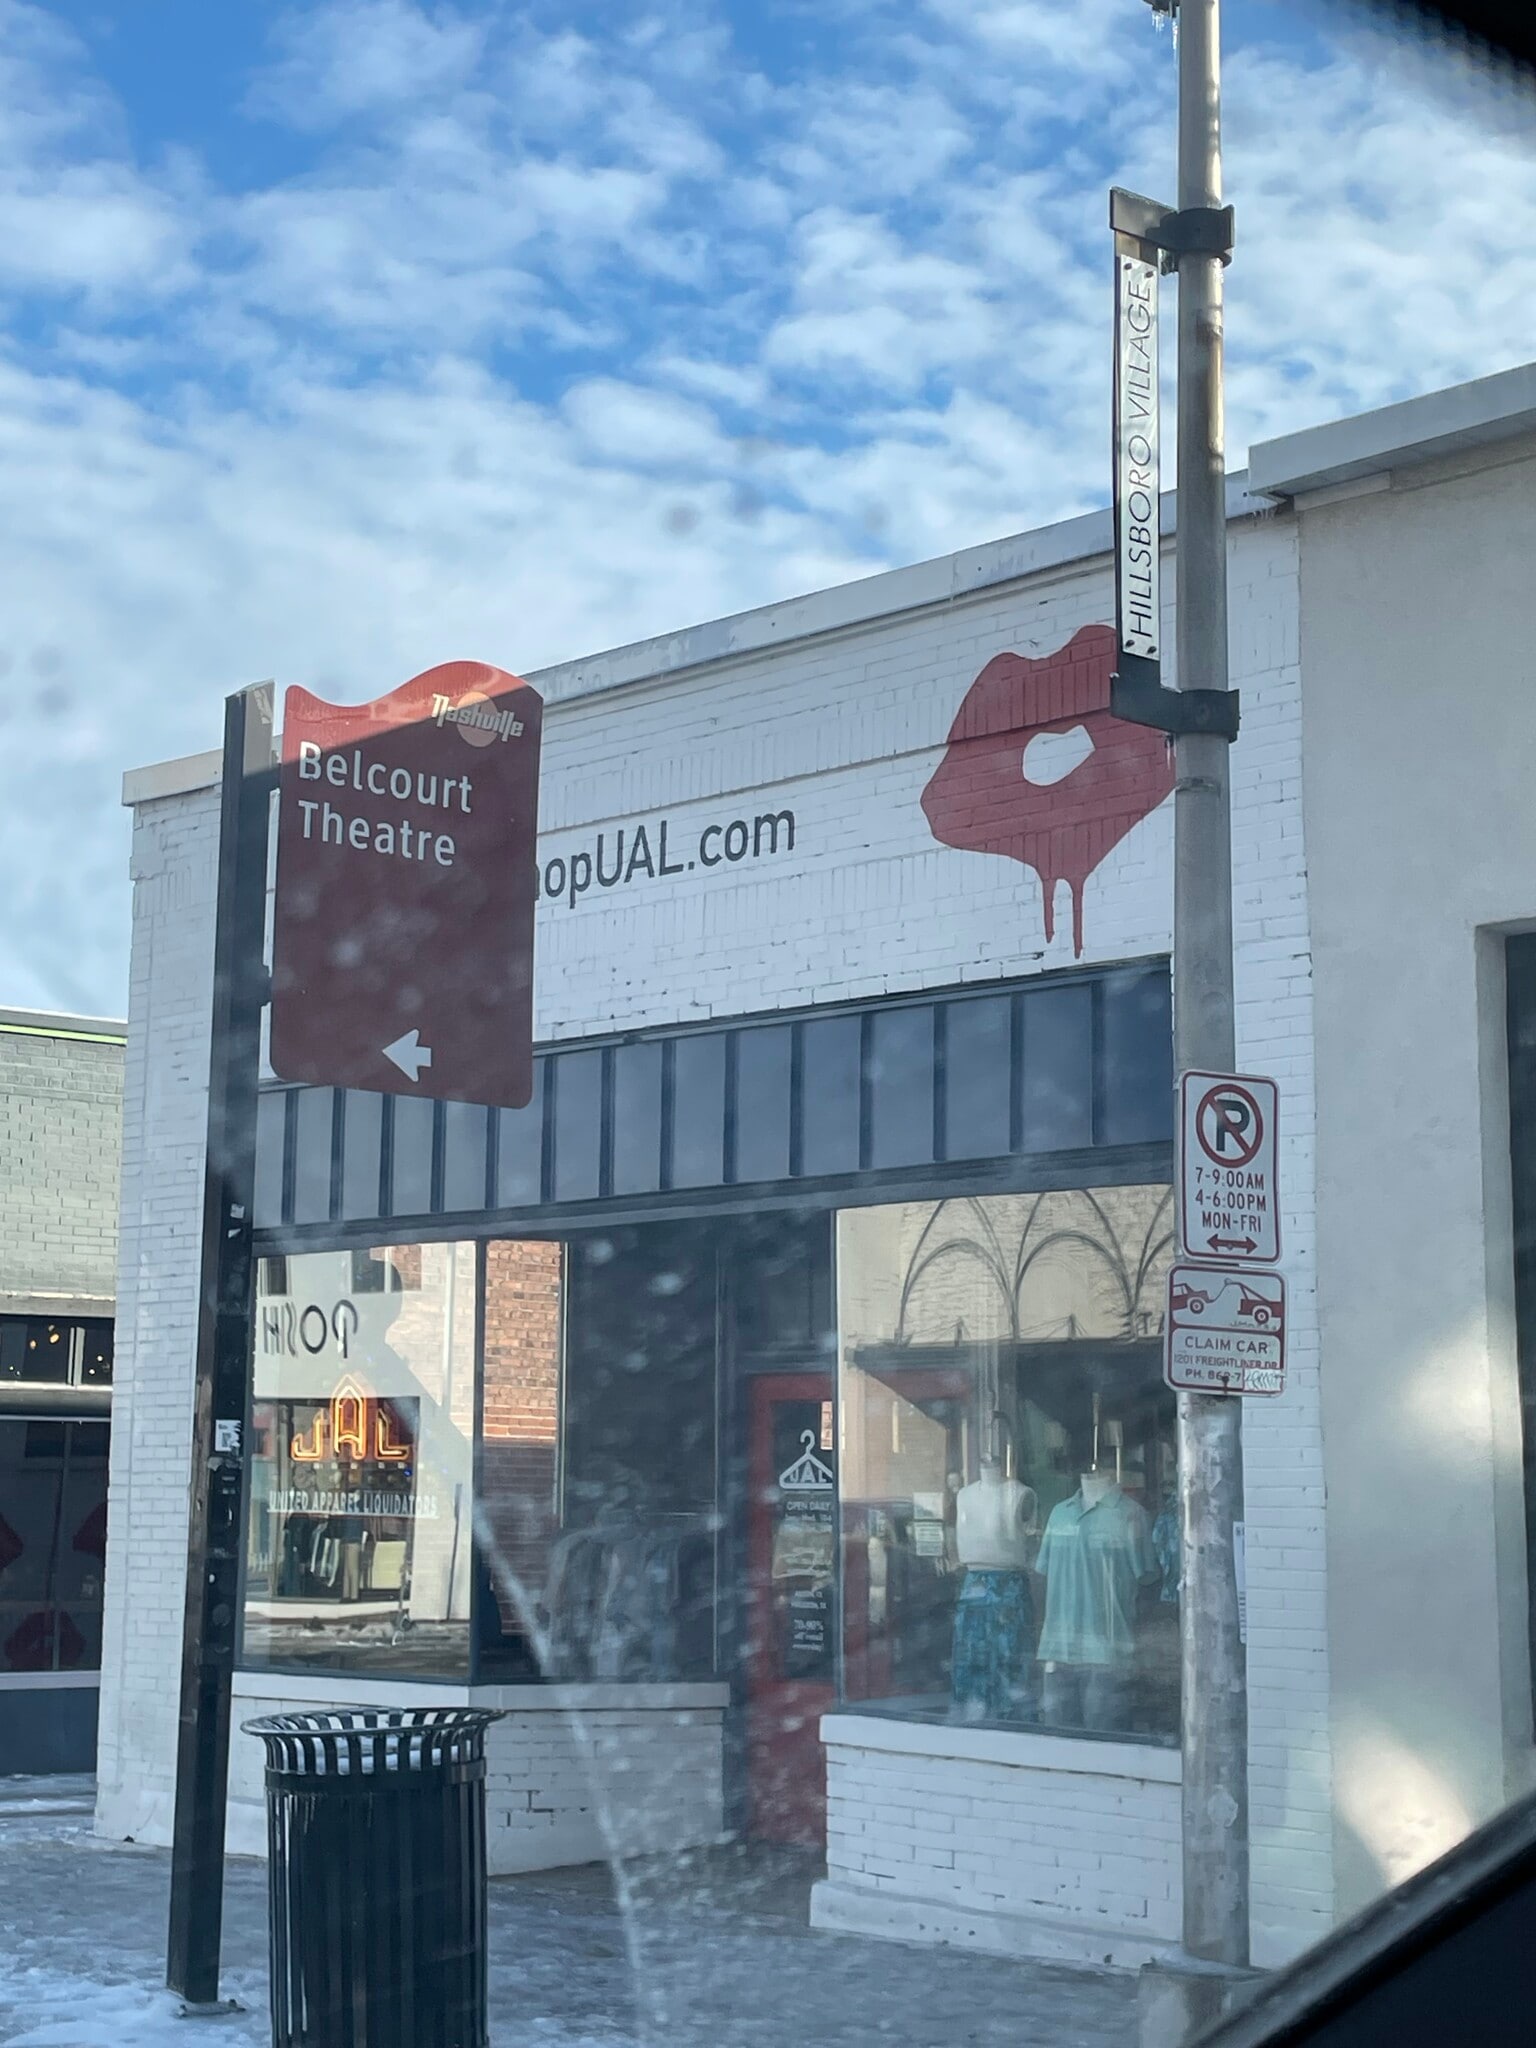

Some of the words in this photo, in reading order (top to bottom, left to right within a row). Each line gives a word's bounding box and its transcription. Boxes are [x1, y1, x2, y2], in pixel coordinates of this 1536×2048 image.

[1127, 280, 1151, 419] VILLAGE
[1128, 434, 1153, 638] HILLSBORO
[299, 740, 473, 814] Belcourt
[298, 799, 456, 866] Theatre
[1201, 1210, 1262, 1233] MON-FRI
[1184, 1335, 1231, 1351] CLAIM
[1236, 1340, 1268, 1355] CAR
[269, 1489, 309, 1511] UNITED
[312, 1490, 360, 1513] APPAREL
[363, 1491, 438, 1516] LIQUIDATORS
